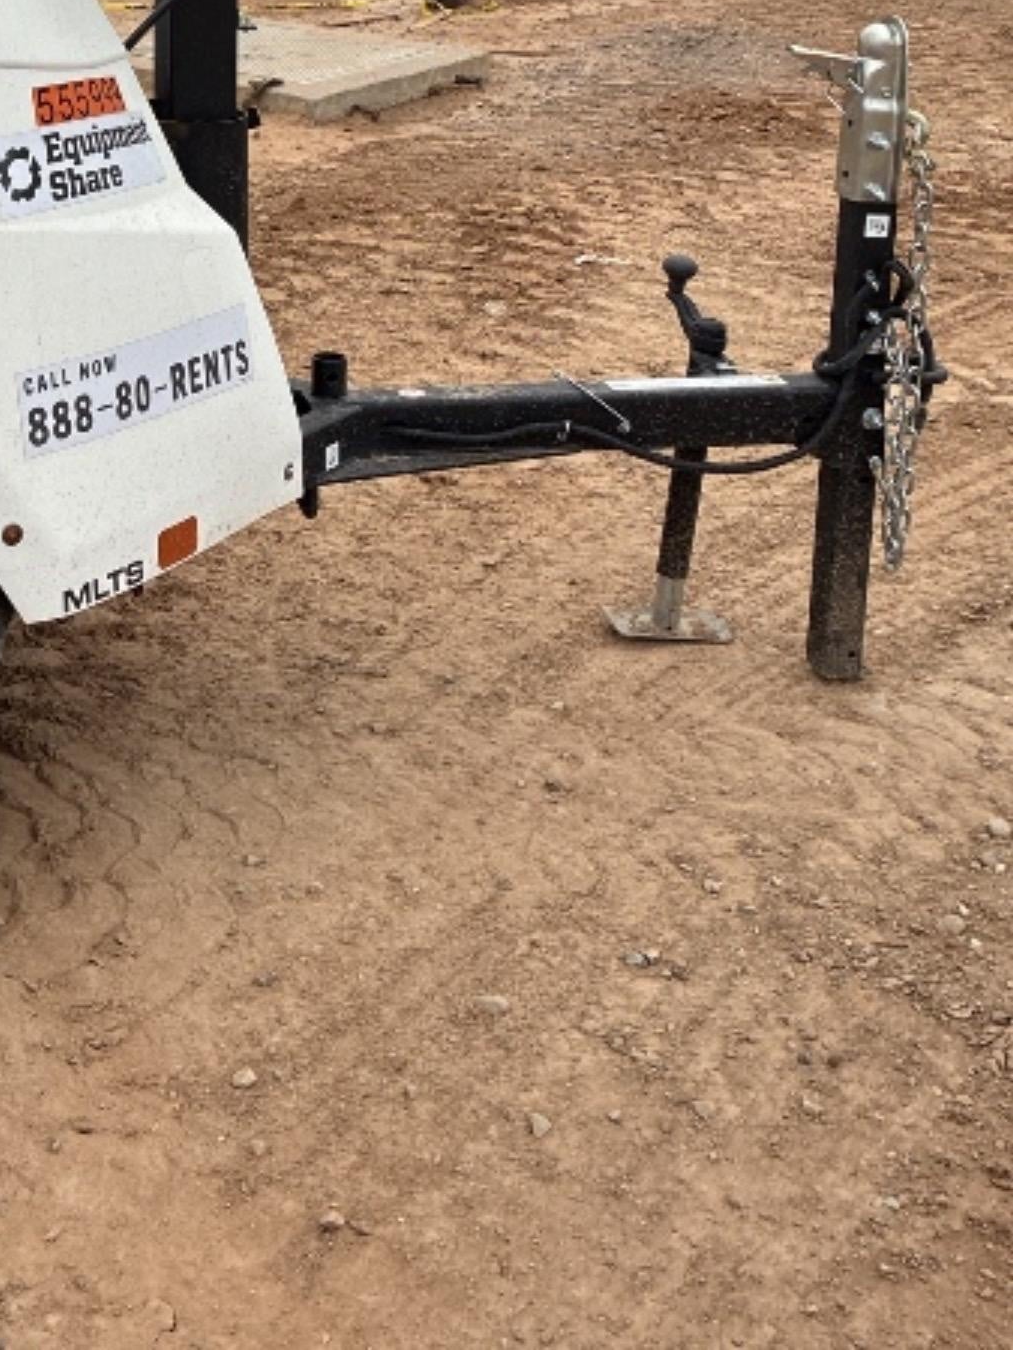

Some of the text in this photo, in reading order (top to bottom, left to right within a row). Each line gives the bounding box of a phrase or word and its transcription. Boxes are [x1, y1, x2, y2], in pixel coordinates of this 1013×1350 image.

[49, 164, 123, 201] Share
[23, 353, 117, 396] CALL NOW
[28, 338, 250, 447] 888-80-RENTS
[63, 560, 143, 612] MLTS
